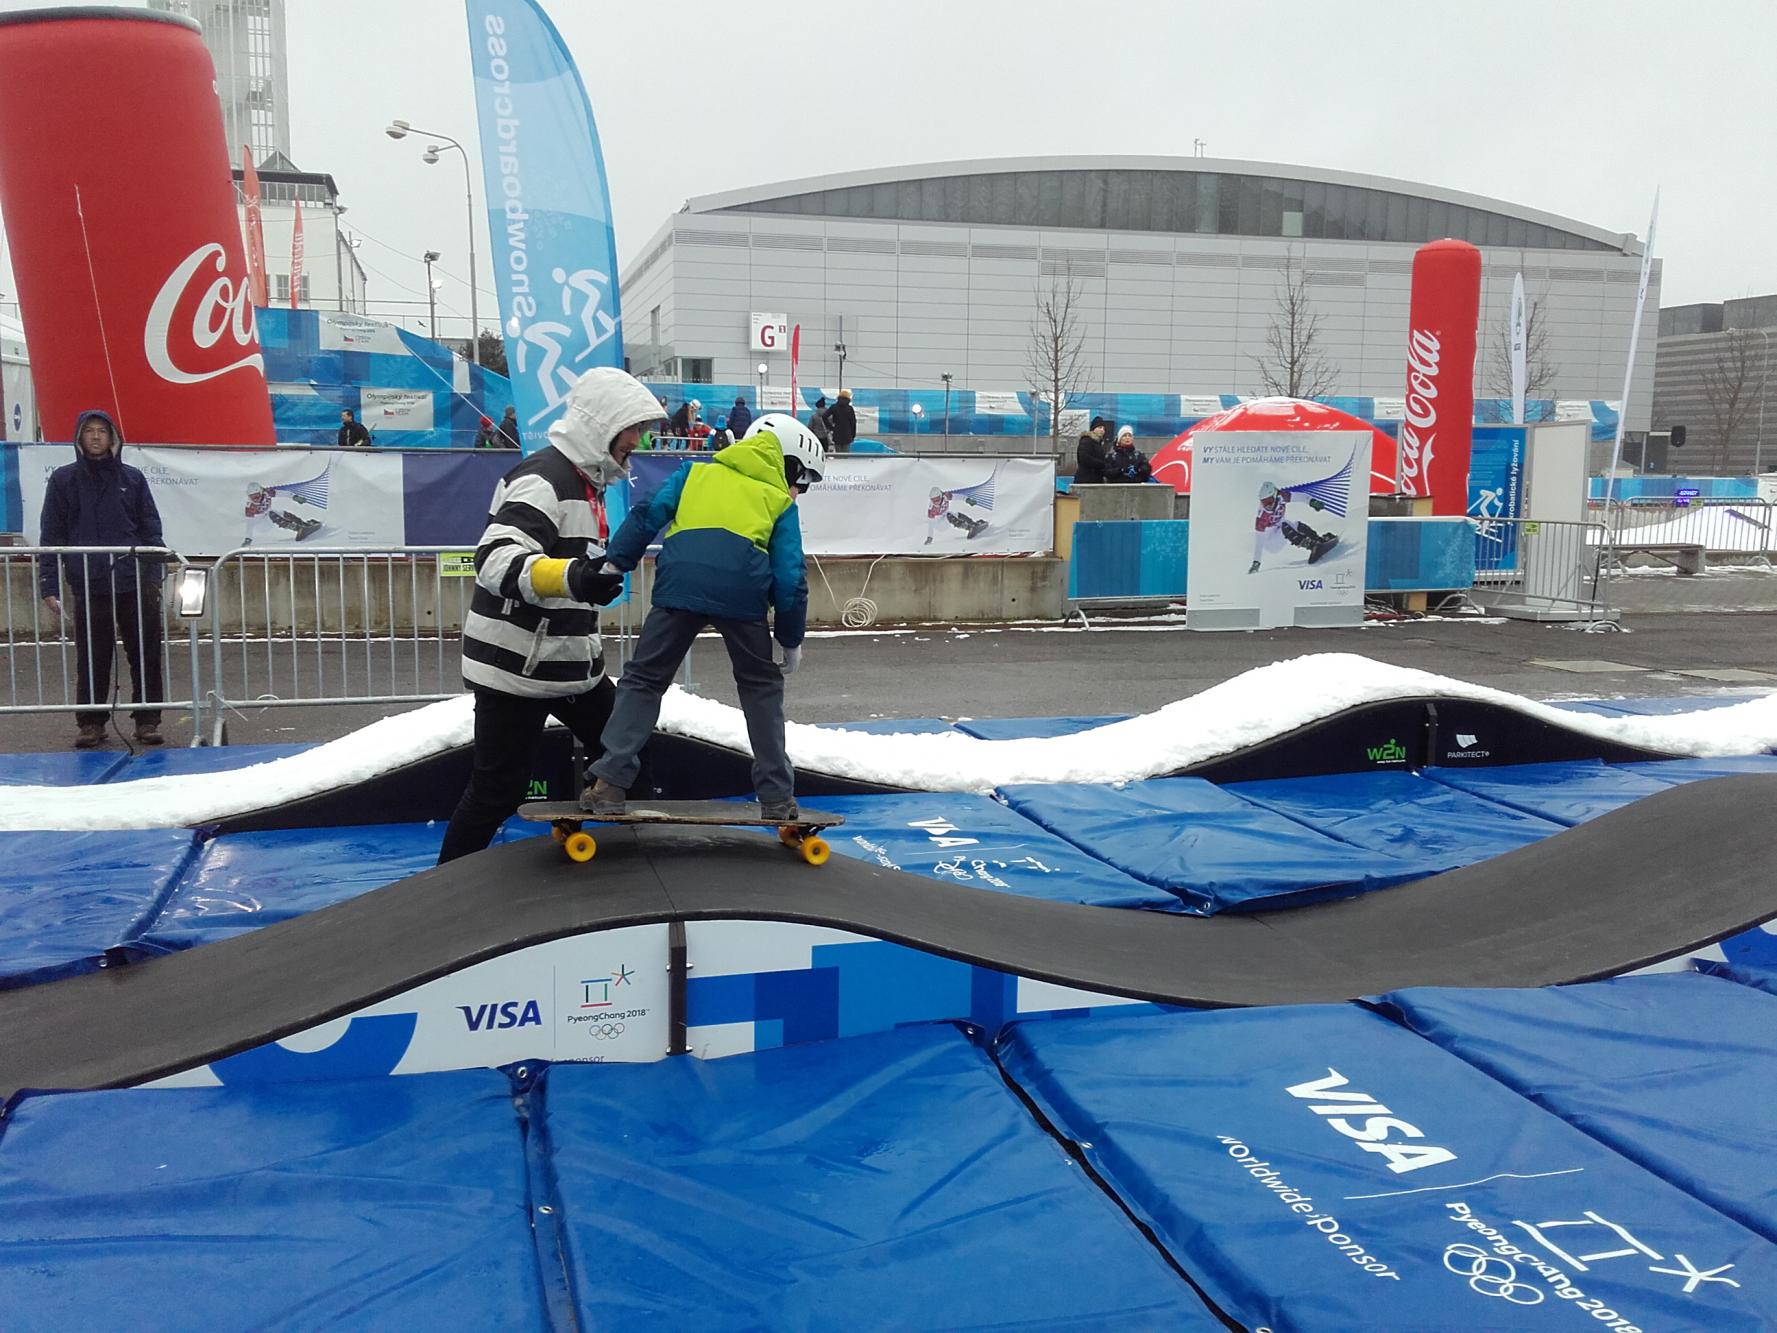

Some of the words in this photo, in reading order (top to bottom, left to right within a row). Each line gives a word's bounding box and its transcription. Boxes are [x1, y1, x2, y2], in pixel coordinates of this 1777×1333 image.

[760, 325, 775, 348] G
[809, 482, 847, 492] OMÁHÁME
[1298, 580, 1323, 590] VISA
[456, 1000, 542, 1032] VISA
[567, 1011, 625, 1024] PyeongChang
[626, 1009, 646, 1018] 2018
[1285, 1067, 1458, 1174] VISA
